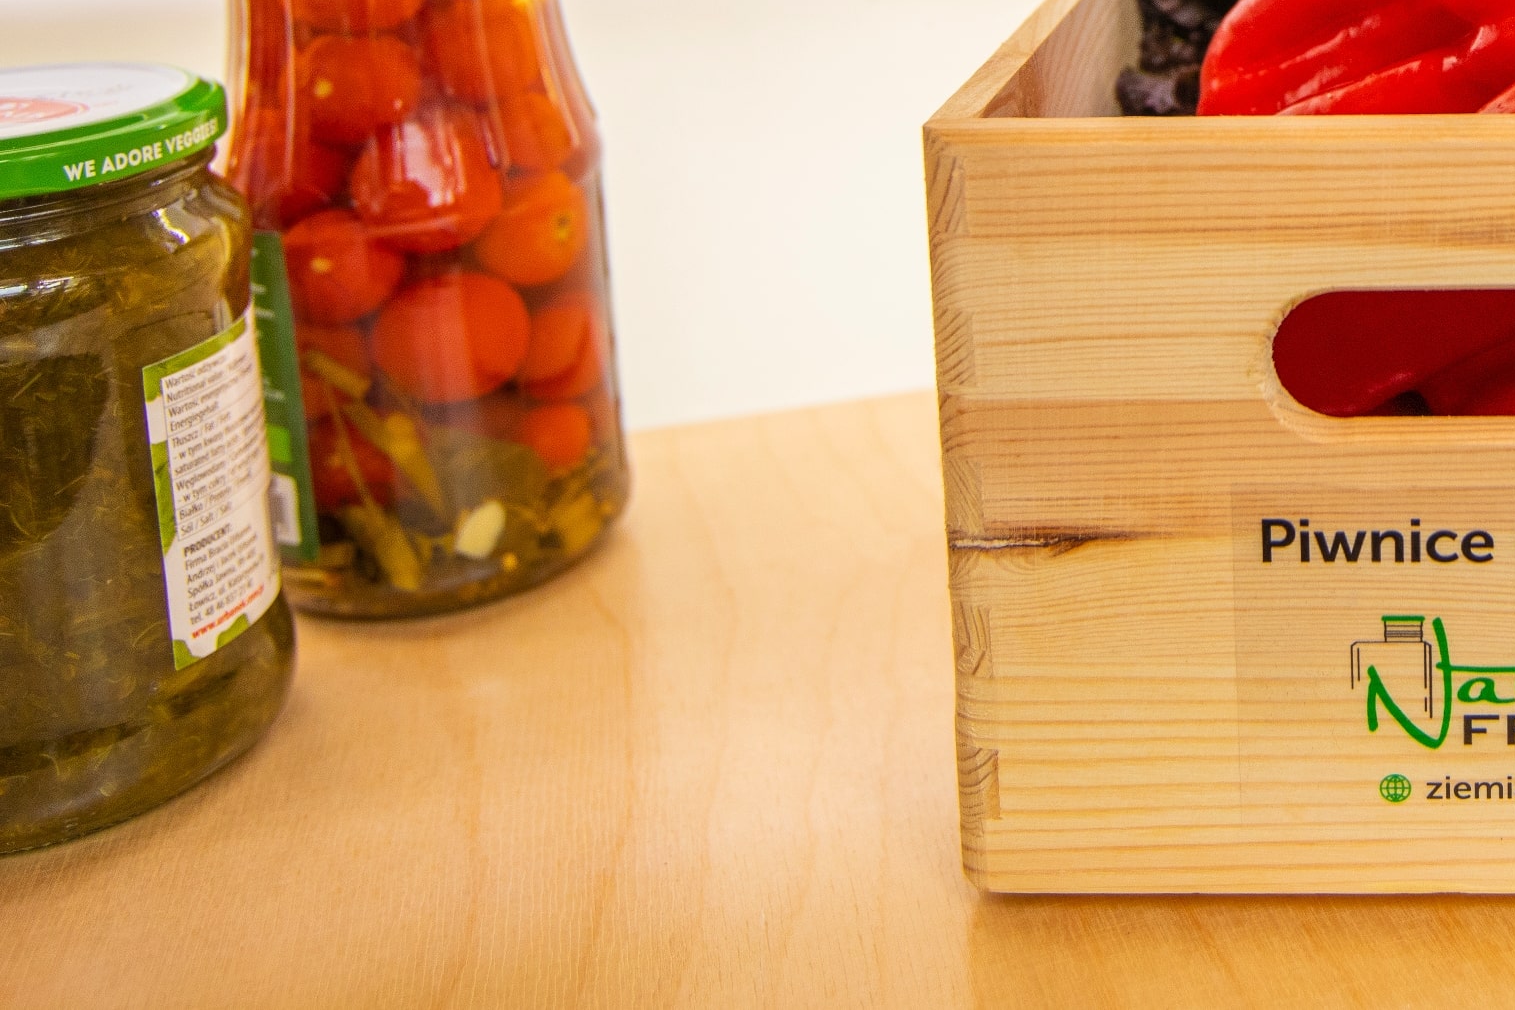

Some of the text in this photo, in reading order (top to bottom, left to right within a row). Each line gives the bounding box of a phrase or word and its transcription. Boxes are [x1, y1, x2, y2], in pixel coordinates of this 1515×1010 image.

[63, 160, 97, 182] WE
[101, 142, 163, 175] ADORE
[1260, 518, 1495, 564] Piwnice
